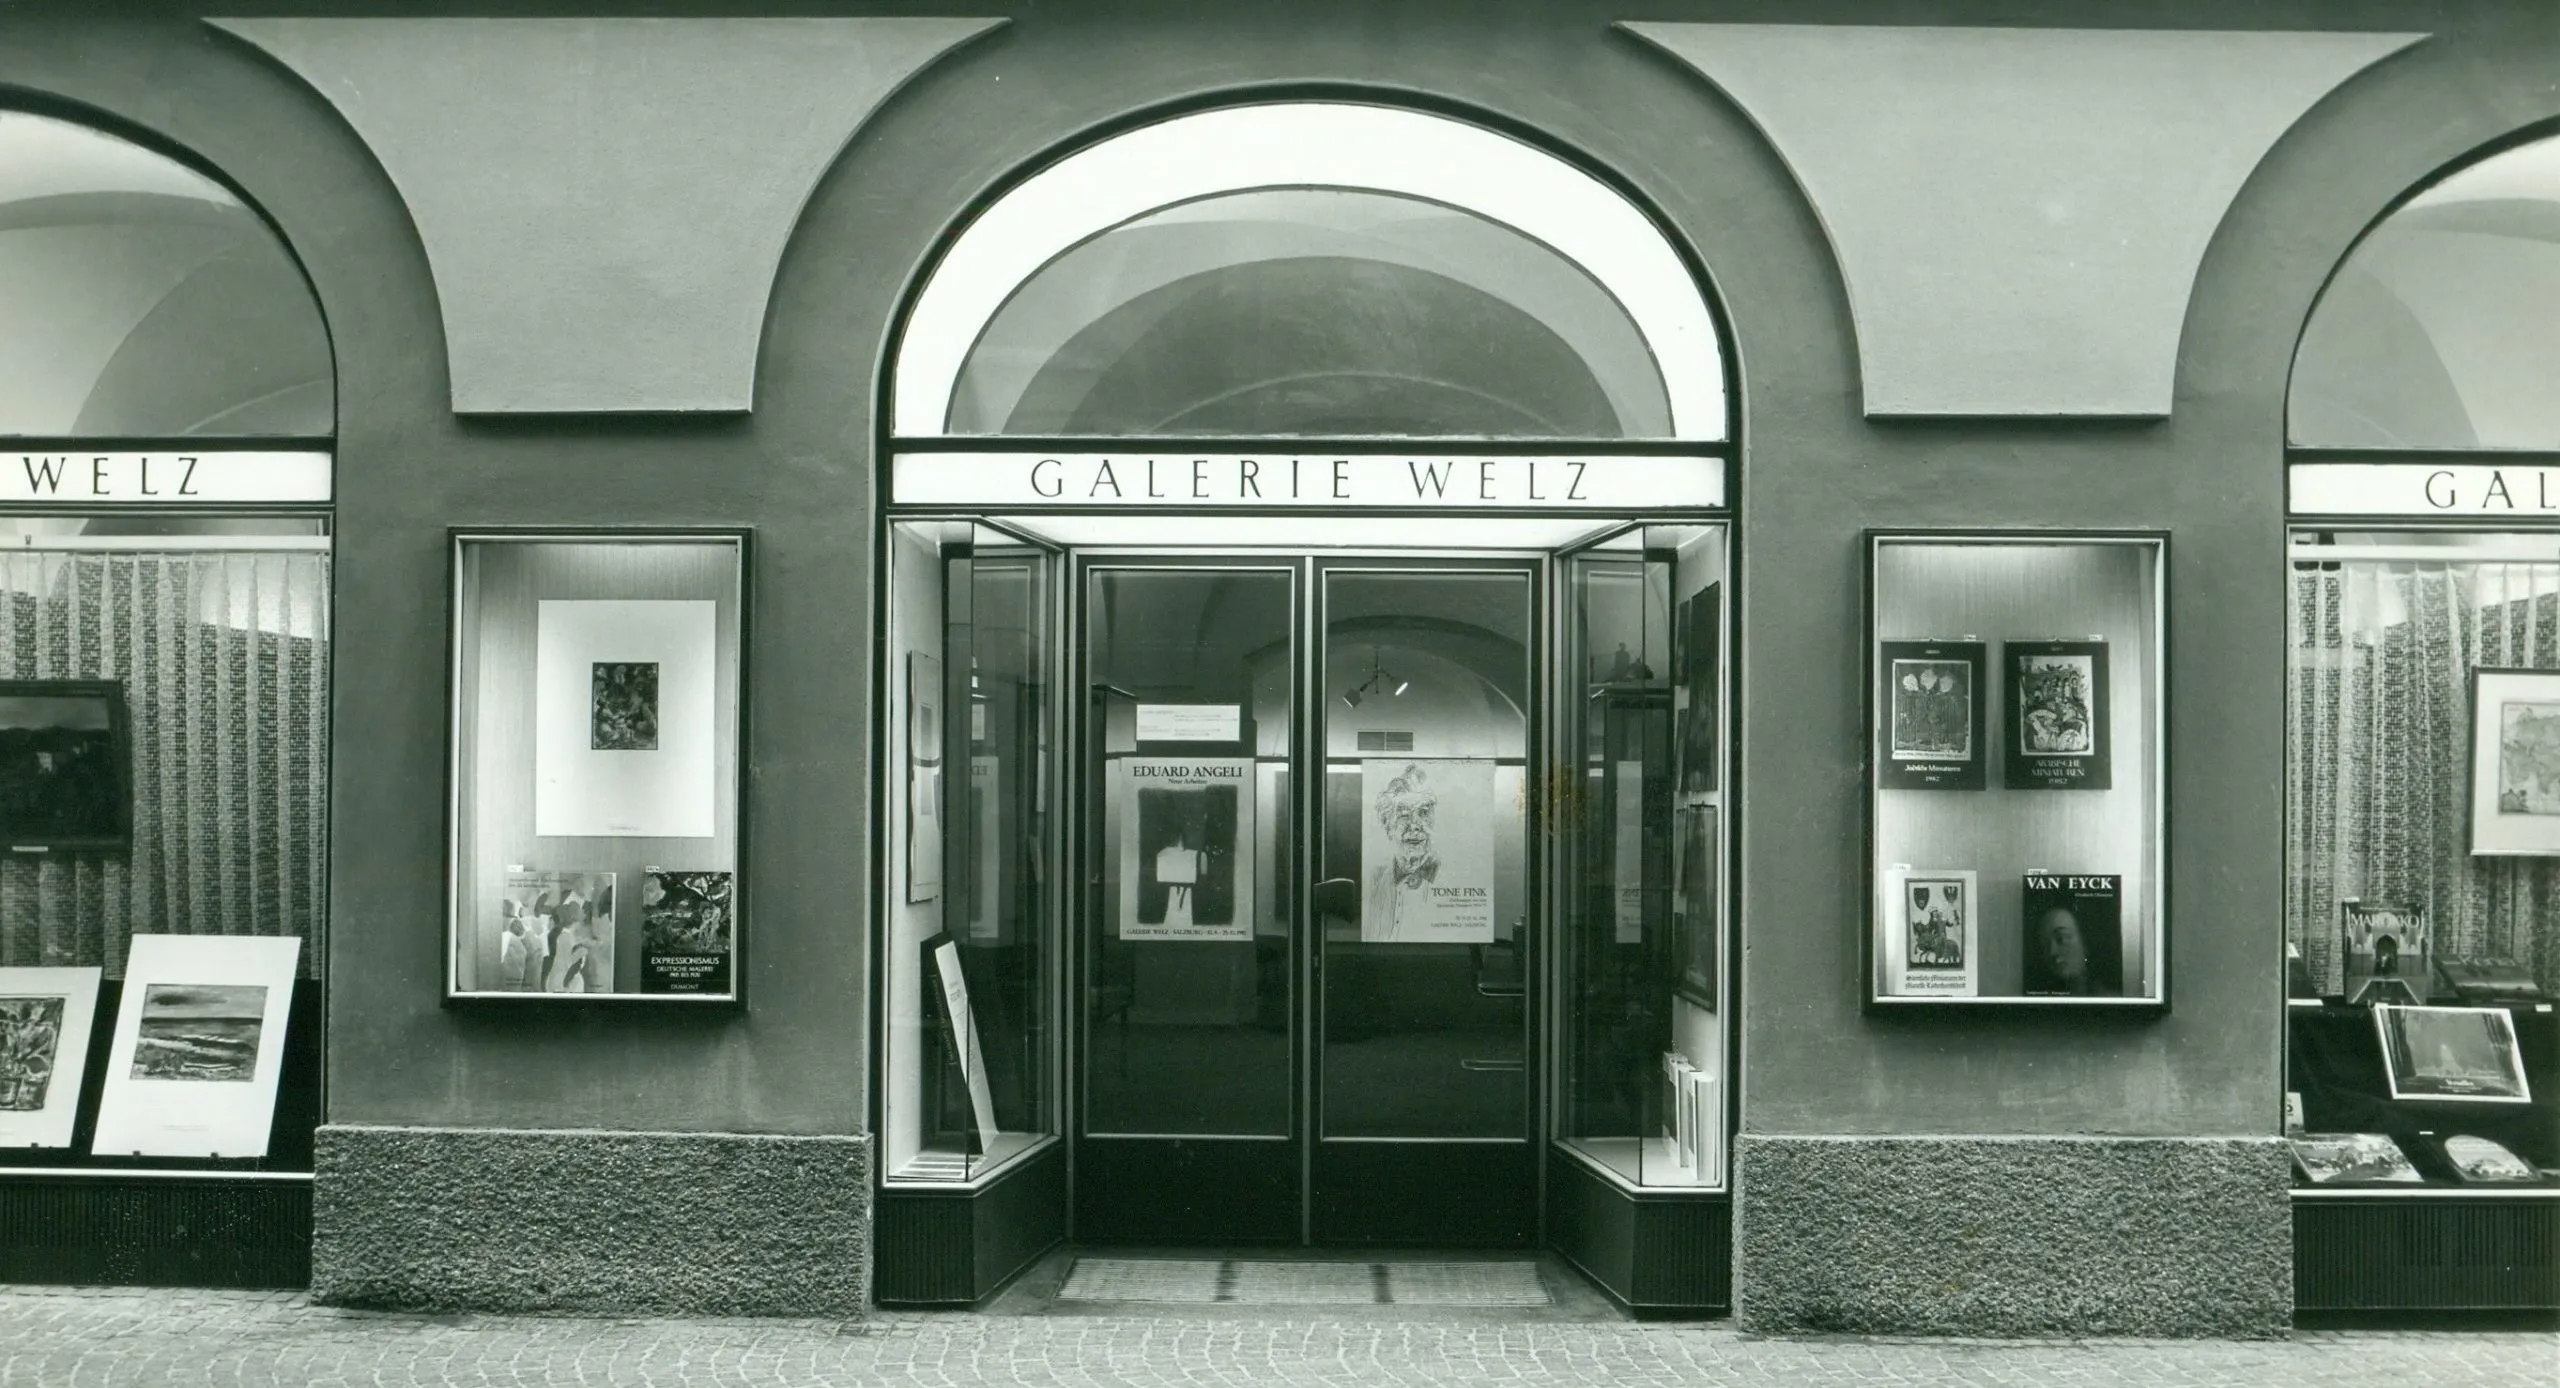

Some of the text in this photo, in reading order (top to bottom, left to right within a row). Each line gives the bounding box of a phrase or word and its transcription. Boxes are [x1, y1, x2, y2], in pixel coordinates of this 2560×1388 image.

[23, 457, 198, 495] WELZ
[1031, 459, 1588, 500] GALERIE WELZ
[2425, 471, 2556, 509] GAL
[1133, 766, 1243, 778] EDUARD ANGELI
[2027, 877, 2113, 889] VAN EYCK
[1431, 887, 1487, 897] TONE FINK
[651, 956, 720, 965] EXPRESSIONISMUS
